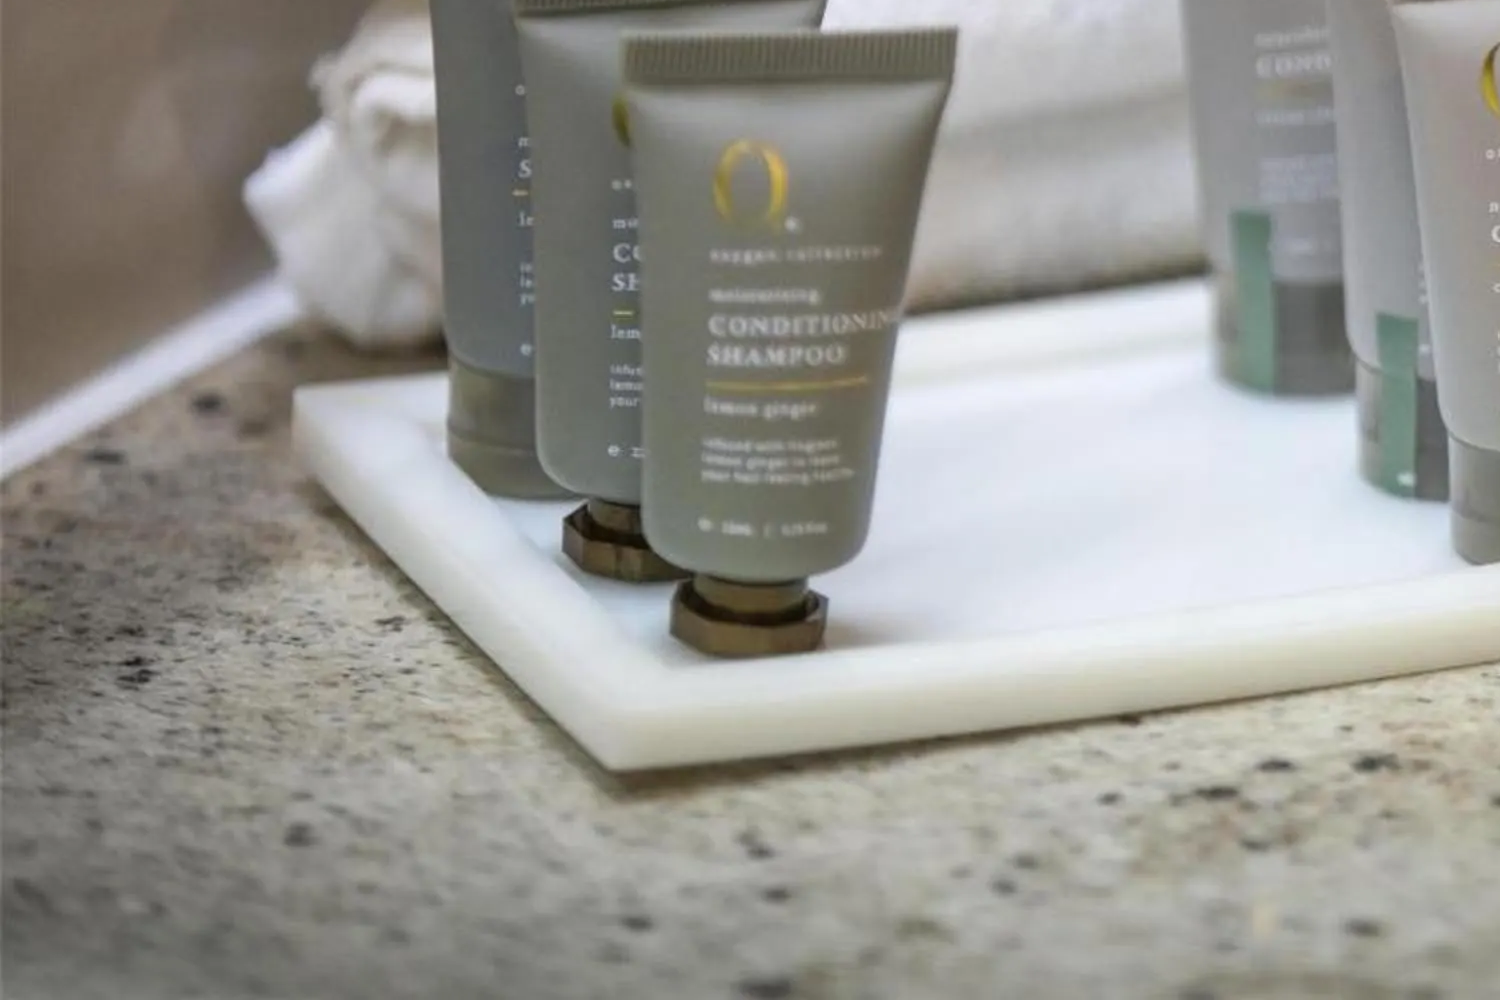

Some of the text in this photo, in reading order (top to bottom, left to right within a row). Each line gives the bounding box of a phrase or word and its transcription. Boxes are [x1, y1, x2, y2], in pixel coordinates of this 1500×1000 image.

[706, 343, 846, 367] SHAMPOO
[702, 395, 817, 421] lemon ginger
